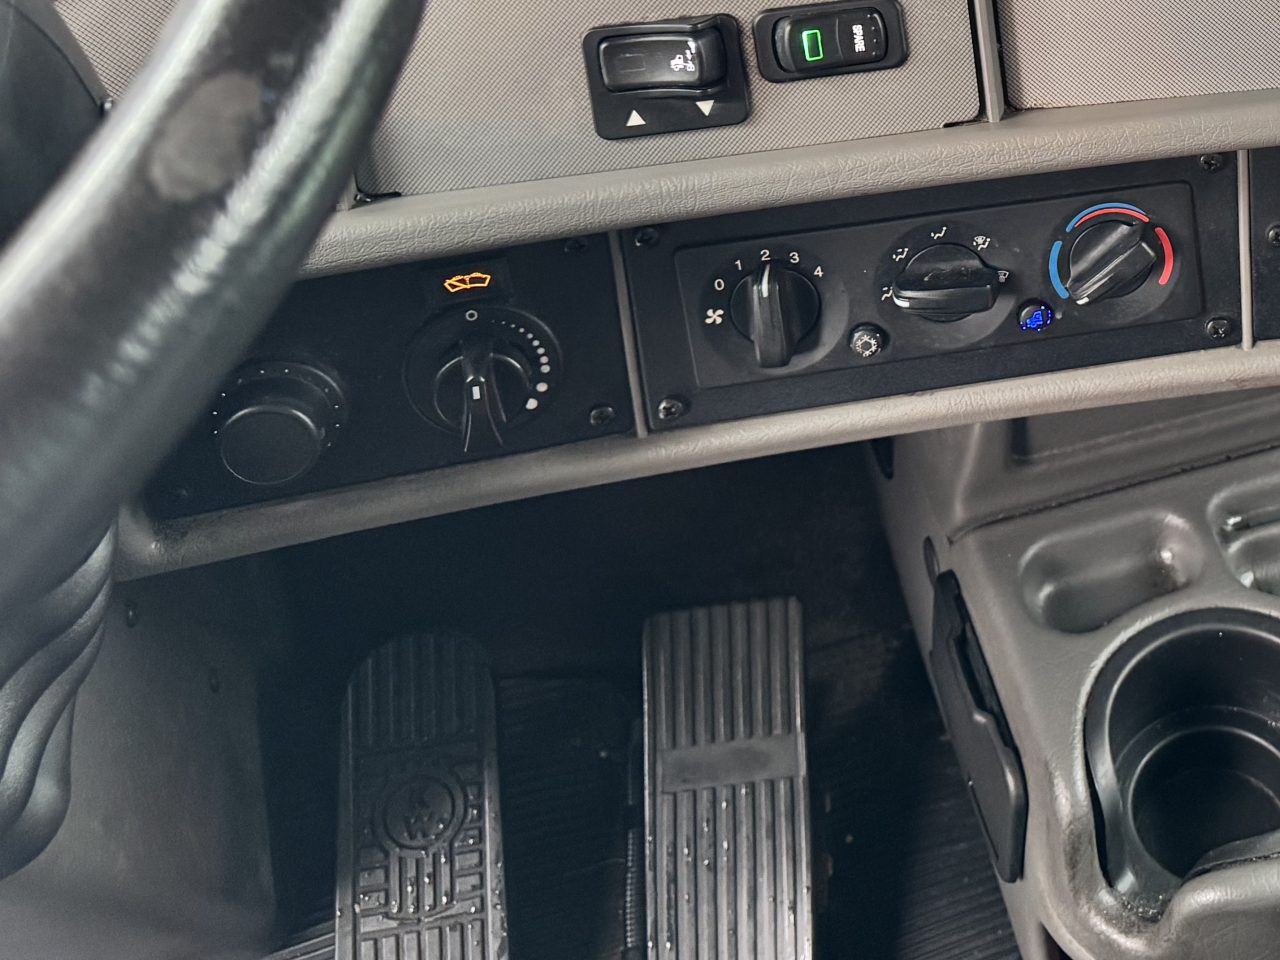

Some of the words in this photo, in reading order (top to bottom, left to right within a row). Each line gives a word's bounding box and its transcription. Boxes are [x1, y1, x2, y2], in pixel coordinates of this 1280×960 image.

[852, 24, 866, 52] SPARE
[714, 278, 725, 291] 0
[735, 260, 742, 270] 1
[760, 249, 771, 261] 2
[789, 252, 800, 263] 3
[814, 266, 824, 277] 4
